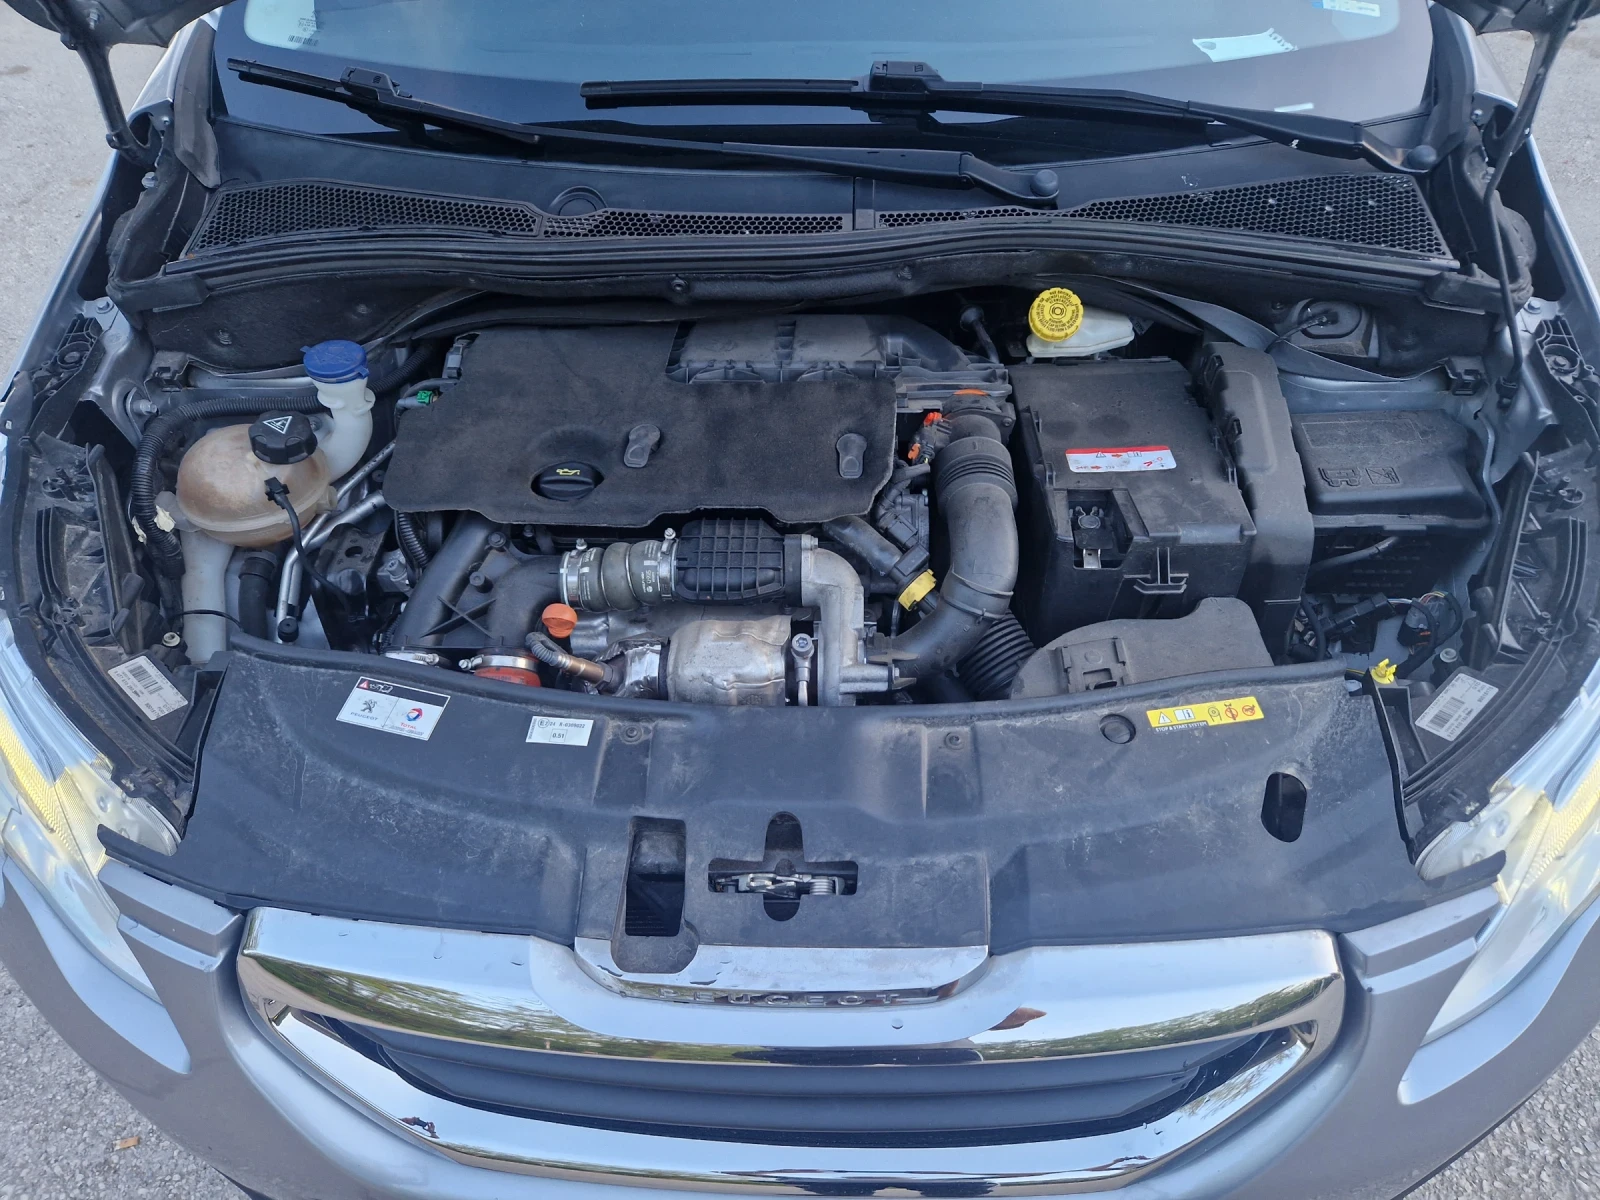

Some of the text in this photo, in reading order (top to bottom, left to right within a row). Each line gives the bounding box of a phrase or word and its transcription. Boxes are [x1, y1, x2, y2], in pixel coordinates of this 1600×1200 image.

[350, 711, 378, 721] PEUGEOT
[400, 722, 417, 730] TOTAL
[658, 988, 900, 1006] PEUGEOT
